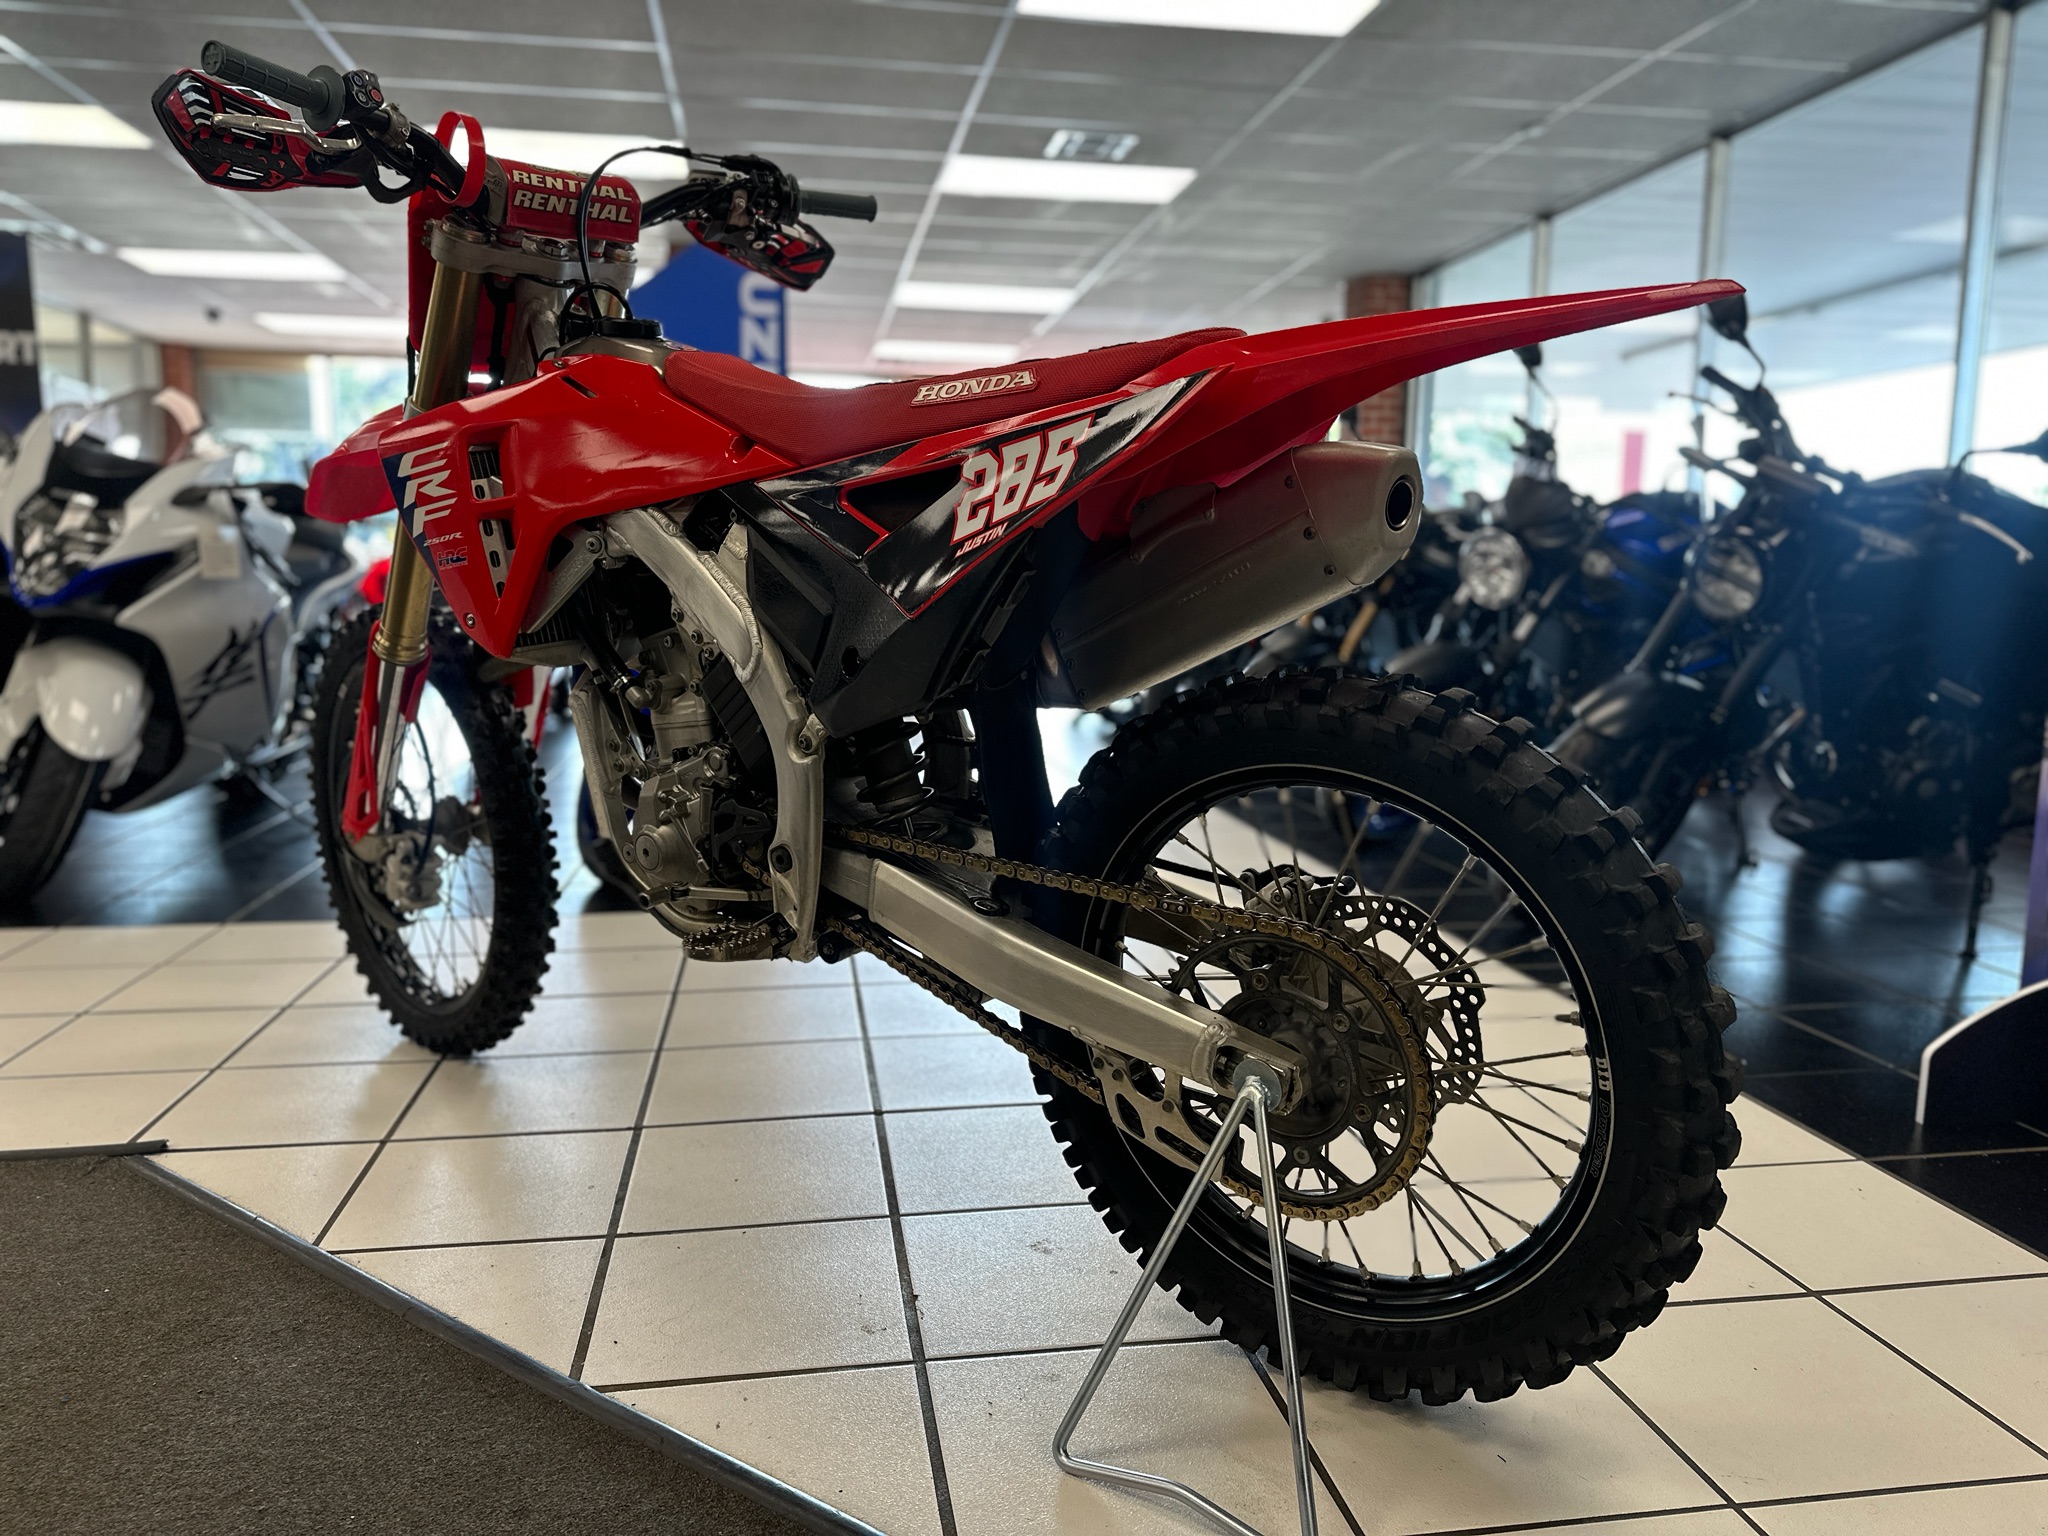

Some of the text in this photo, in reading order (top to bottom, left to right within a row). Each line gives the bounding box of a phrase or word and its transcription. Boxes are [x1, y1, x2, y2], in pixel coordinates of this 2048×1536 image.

[513, 190, 633, 224] RENTHAL
[913, 370, 1034, 401] HONDA
[397, 441, 459, 539] CRF
[952, 414, 1095, 544] 285
[423, 531, 465, 547] 250R
[953, 521, 1009, 560] JUSTIN
